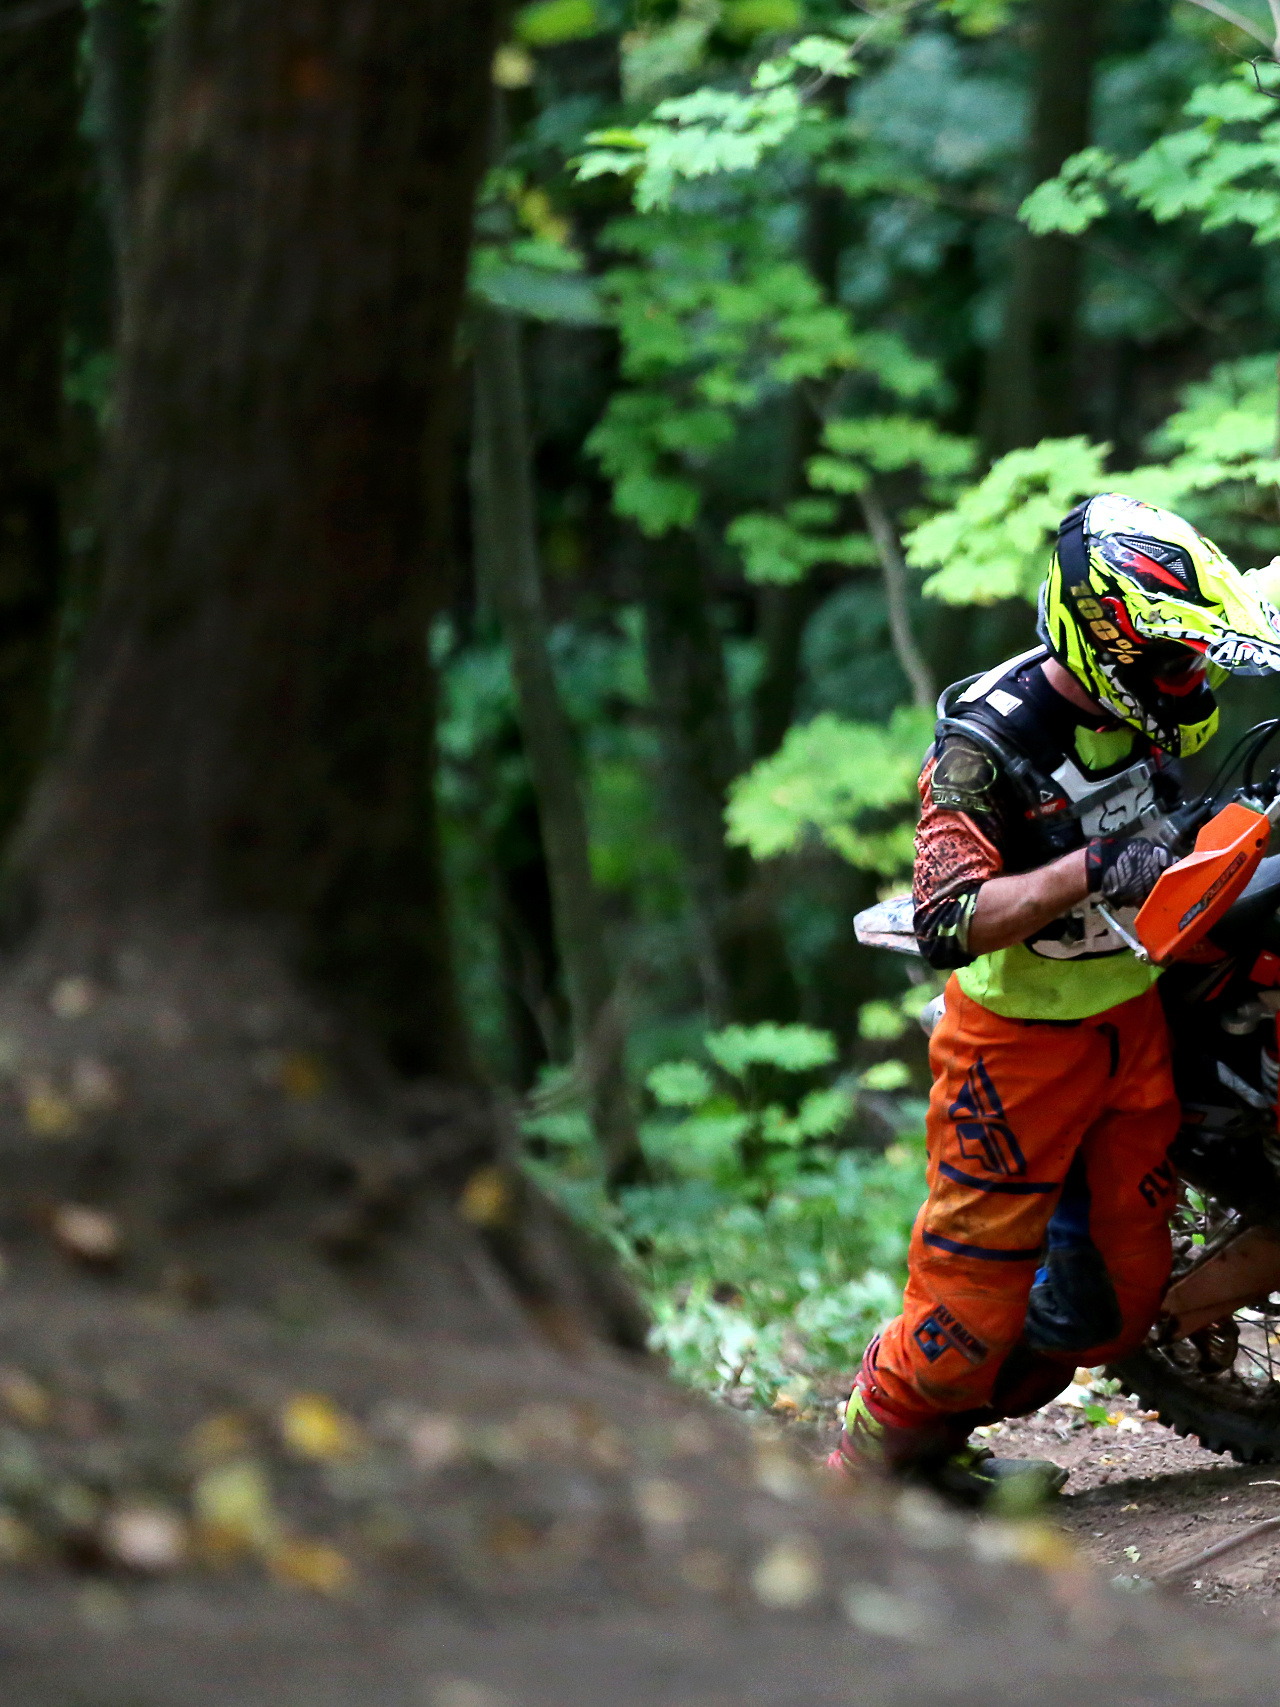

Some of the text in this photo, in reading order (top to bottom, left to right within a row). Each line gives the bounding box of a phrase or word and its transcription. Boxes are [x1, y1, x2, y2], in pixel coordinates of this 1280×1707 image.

[1070, 580, 1143, 667] 100%
[1137, 1163, 1174, 1207] FLY
[932, 1303, 956, 1326] FLY
